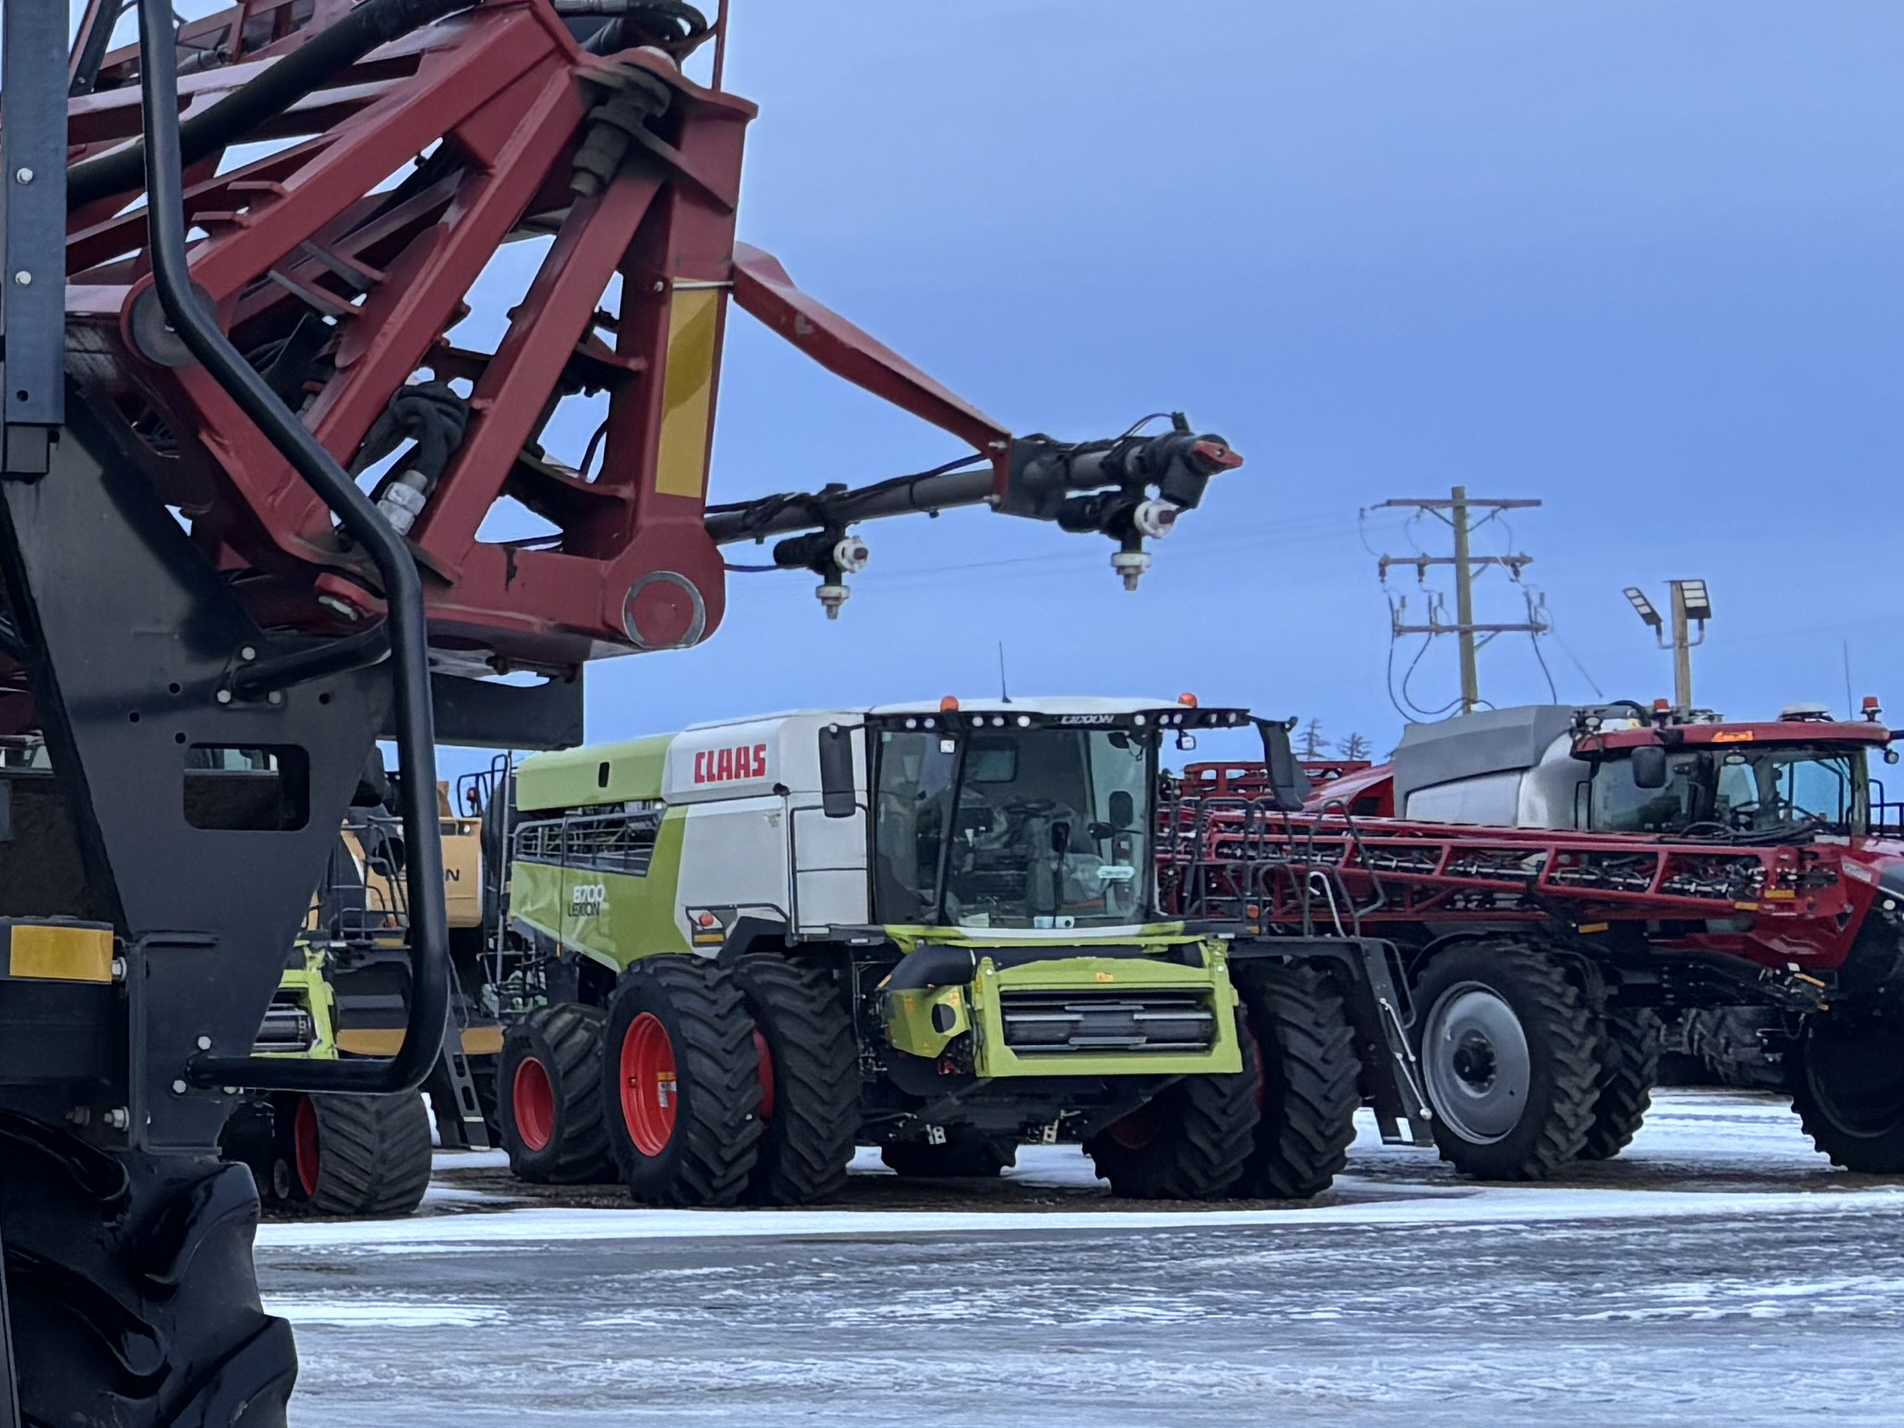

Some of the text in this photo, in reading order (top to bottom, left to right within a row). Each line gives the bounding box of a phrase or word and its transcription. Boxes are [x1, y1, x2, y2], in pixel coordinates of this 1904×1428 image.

[694, 743, 767, 784] CLAAS
[573, 883, 606, 903] 8700
[567, 901, 601, 918] LEXION
